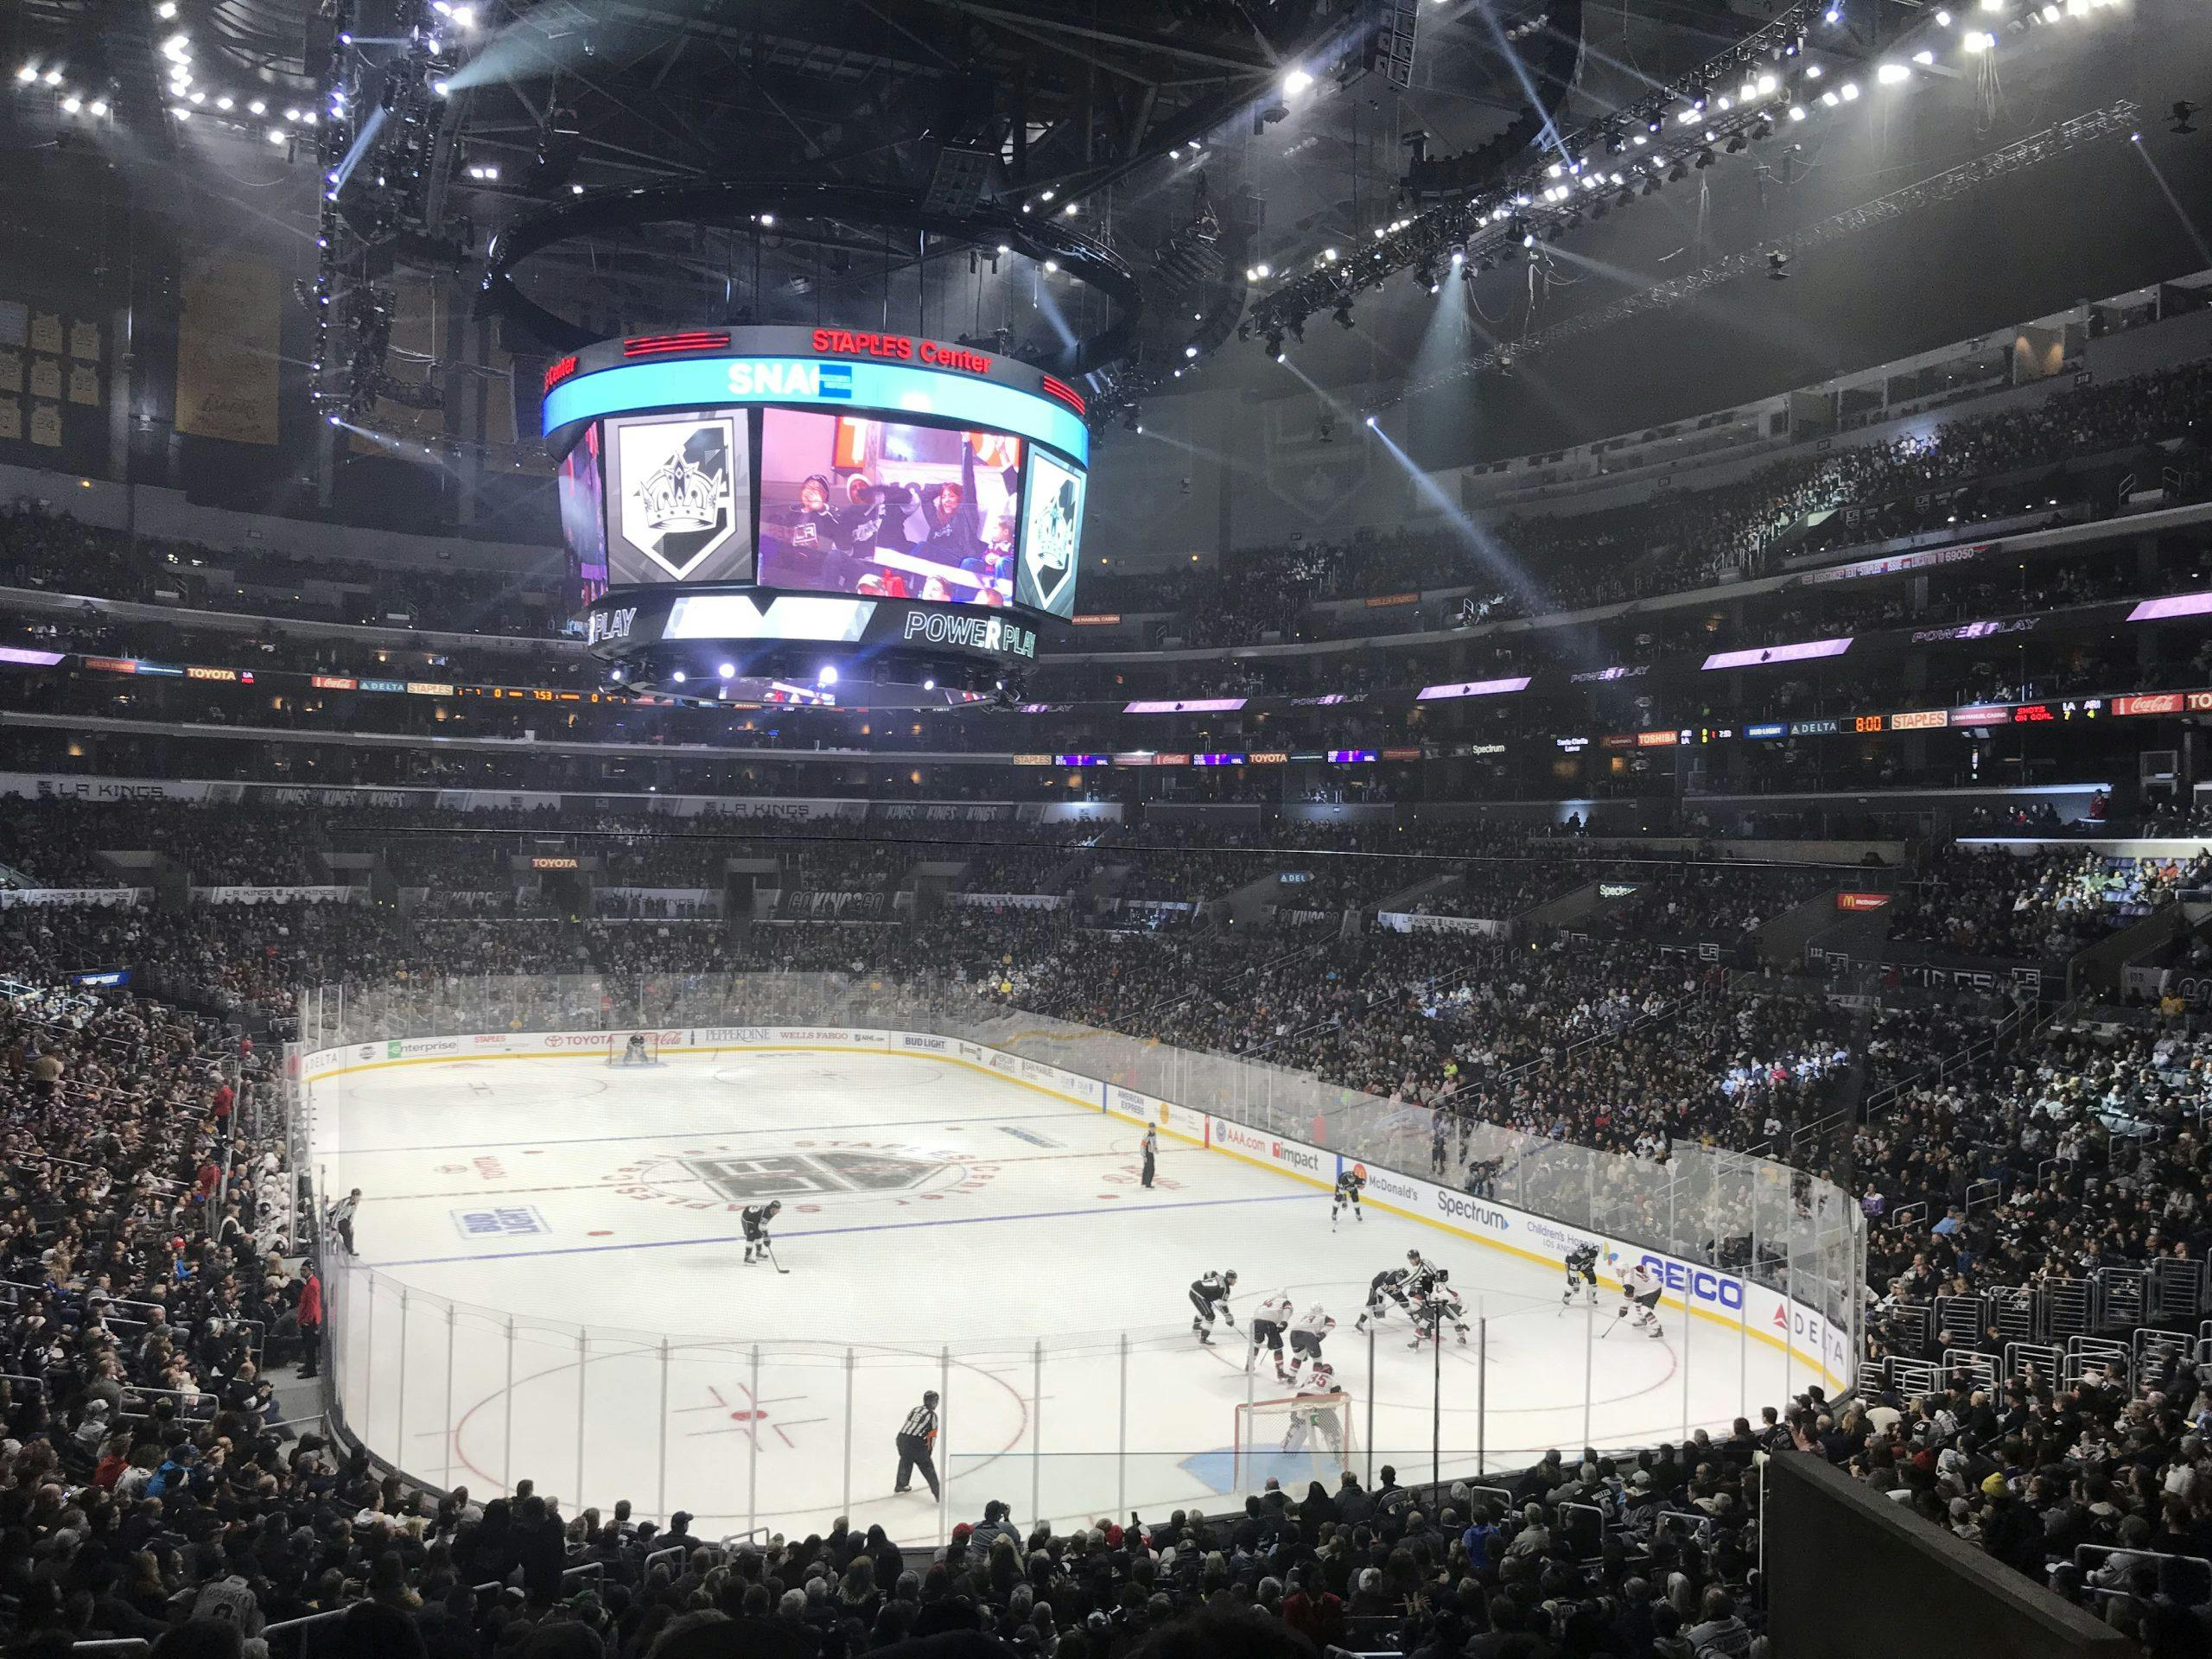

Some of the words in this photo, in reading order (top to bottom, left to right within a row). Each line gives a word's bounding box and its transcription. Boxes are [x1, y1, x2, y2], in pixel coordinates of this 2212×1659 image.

[812, 329, 912, 359] STAPLES
[919, 340, 992, 373] Center
[1946, 548, 1974, 562] 69050
[595, 607, 637, 639] PLAY
[905, 611, 1001, 650] POWER
[1002, 624, 1036, 658] PLAY
[188, 668, 237, 680] TOYOTA
[372, 683, 404, 692] DELTA
[409, 683, 452, 695] STAPLES
[2017, 705, 2046, 714] SHOTS
[2063, 702, 2075, 711] LA
[1893, 713, 1945, 728] STAPLES
[2087, 709, 2095, 719] 4
[1802, 722, 1836, 733] DELTA
[1855, 716, 1882, 732] 8:00
[1638, 733, 1677, 744] TOSHIBA
[1472, 743, 1505, 755] Spectrum
[1014, 754, 1052, 765] STAPLES
[1249, 753, 1287, 763] TOYOTA
[60, 783, 89, 796] LA
[99, 785, 163, 798] KINGS
[722, 803, 748, 815] LA
[753, 804, 810, 816] KINGS
[532, 858, 577, 868] TOYOTA
[474, 1035, 506, 1044] STAPLES
[566, 1035, 615, 1046] TOYOTA
[705, 1028, 770, 1043] PEPPERDINE
[780, 1032, 815, 1041] WELLS
[817, 1032, 849, 1040] FARGO
[391, 1040, 457, 1054] enterprise
[905, 1036, 923, 1046] BUD
[924, 1039, 945, 1050] LIGHT
[309, 1052, 338, 1070] DELTA
[1118, 1090, 1144, 1105] AMERICAN
[1121, 1100, 1144, 1116] EXPRESS
[1228, 1128, 1266, 1154] AAA.com
[1281, 1141, 1319, 1171] impact
[1369, 1174, 1418, 1201] McDonald's
[1438, 1191, 1504, 1230] Spectrum
[1527, 1221, 1565, 1243] Children's
[1542, 1238, 1554, 1248] LOS
[1642, 1255, 1743, 1310] GEICO
[1795, 1313, 1844, 1365] DELTA
